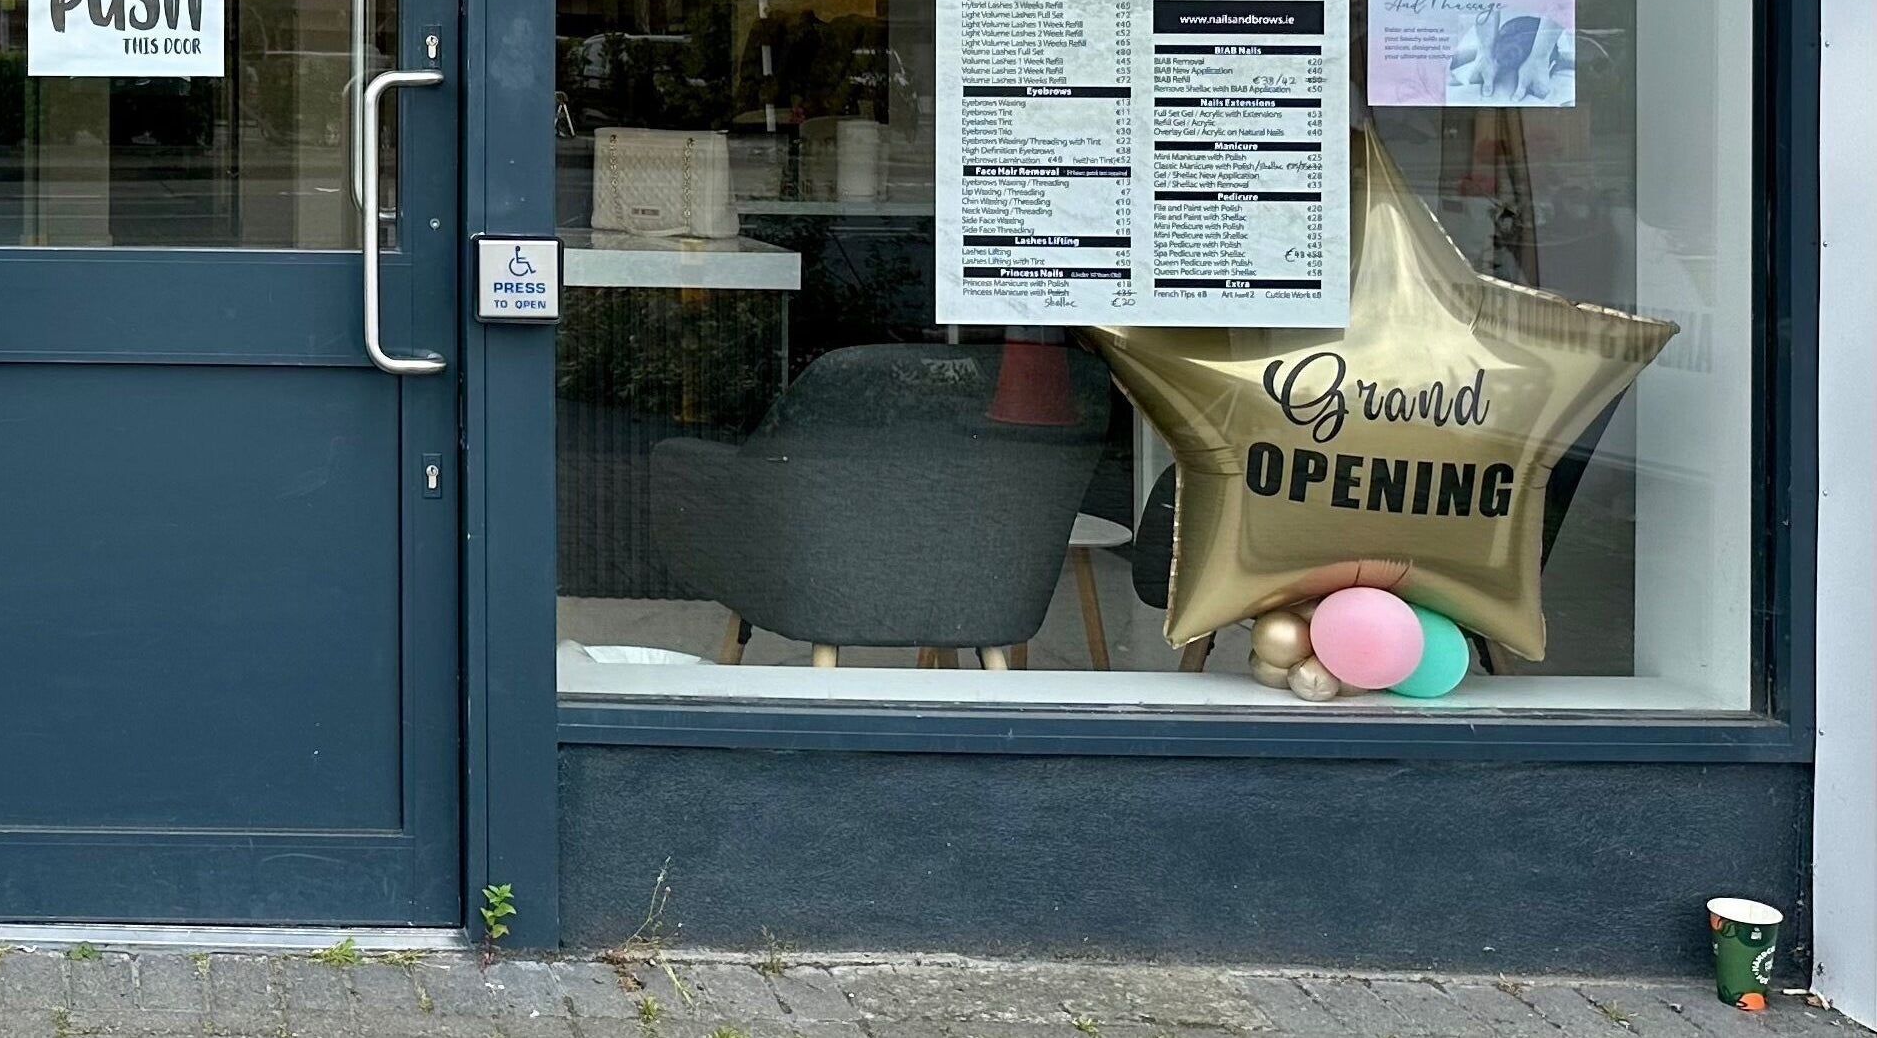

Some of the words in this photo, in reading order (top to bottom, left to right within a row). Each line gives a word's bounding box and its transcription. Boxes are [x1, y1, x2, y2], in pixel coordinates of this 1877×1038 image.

[1180, 14, 1294, 24] www.nailsandbrows.ie
[123, 37, 159, 54] THIS
[164, 38, 201, 54] DOOR
[1238, 47, 1261, 55] Nails
[1027, 87, 1072, 96] Eyebrows
[1200, 99, 1223, 107] Nails
[1224, 99, 1275, 107] Extensions
[1215, 142, 1258, 150] Manicure
[976, 167, 996, 176] Face
[998, 167, 1017, 176] Hair
[1019, 168, 1060, 176] Removal
[1015, 237, 1046, 245] Lashes
[1048, 237, 1079, 247] Lifting
[1000, 269, 1039, 277] Princess
[1040, 269, 1063, 277] Nails
[494, 283, 545, 293] PRESS
[1226, 280, 1250, 288] Extra
[1180, 291, 1195, 299] Tips
[494, 300, 507, 308] TO
[515, 300, 546, 309] OPEN
[1263, 352, 1489, 443] Grand
[1246, 441, 1514, 518] OPENING
